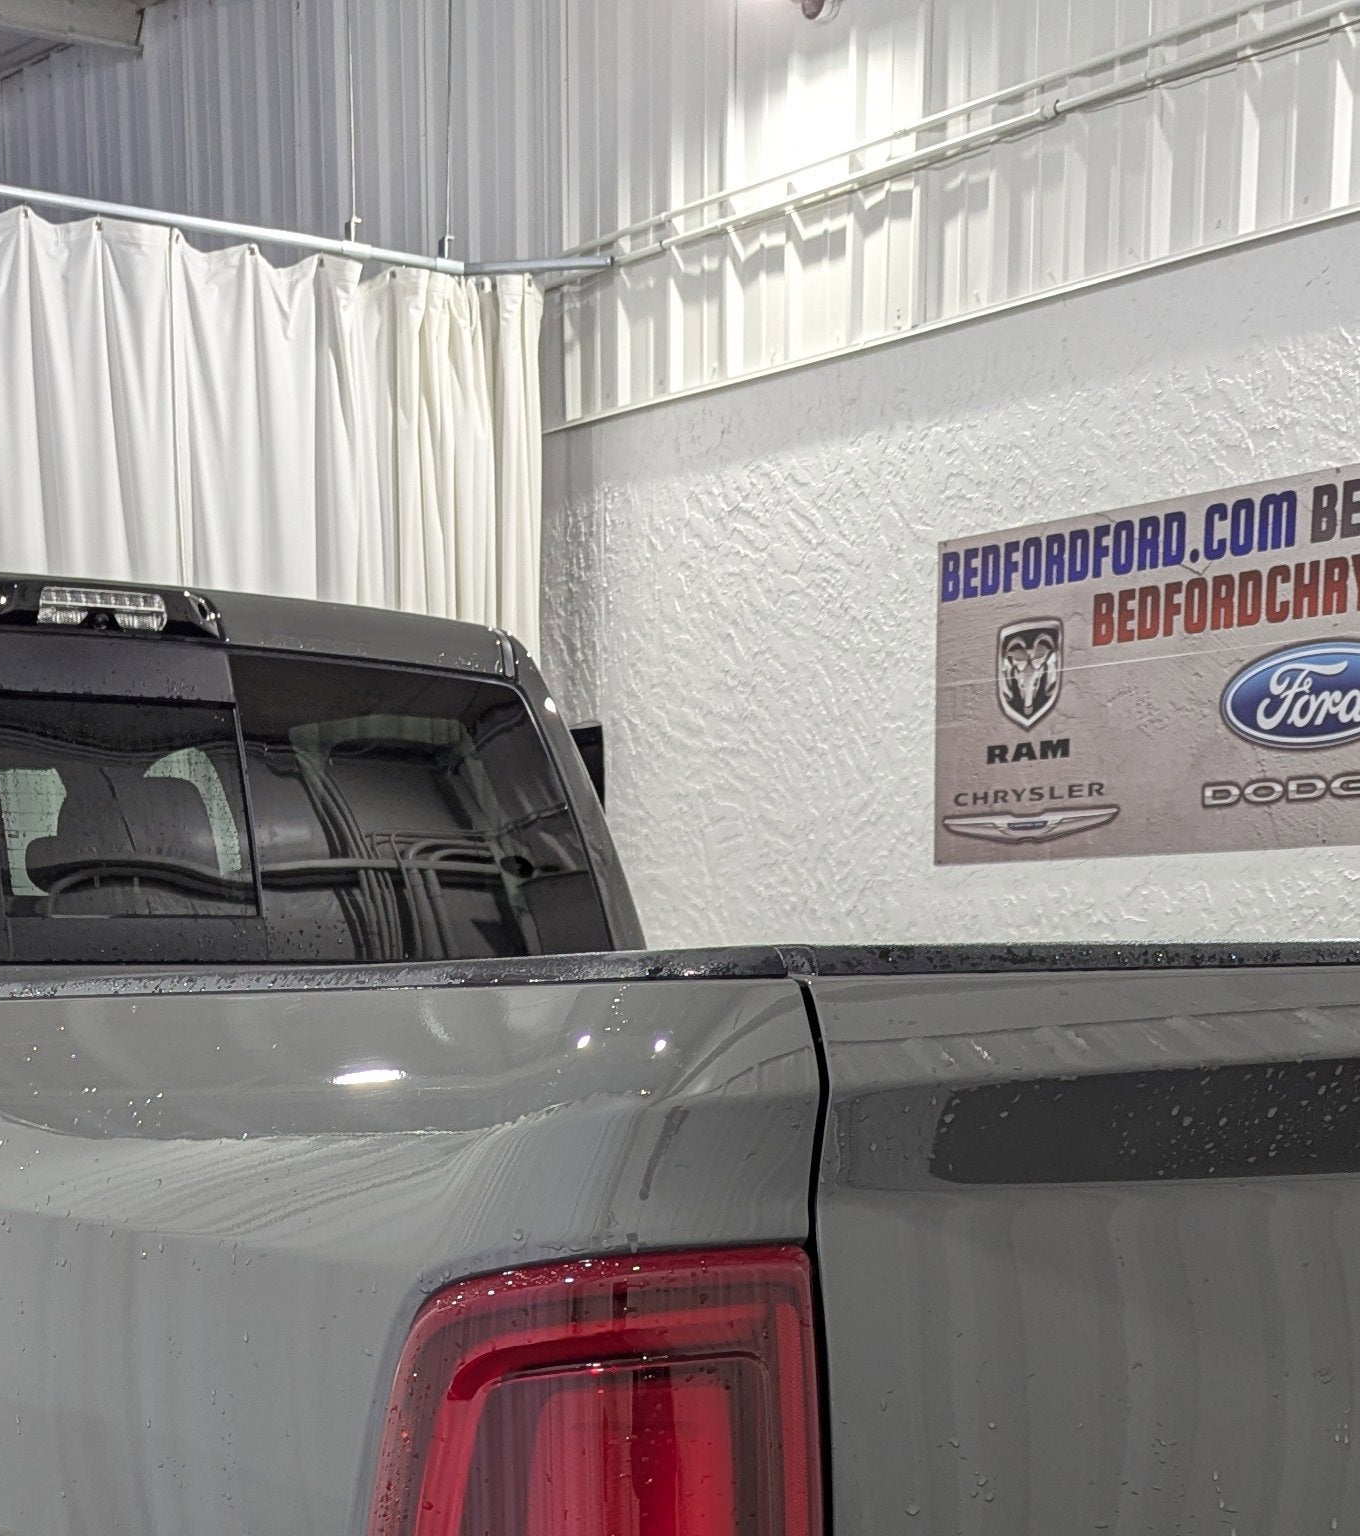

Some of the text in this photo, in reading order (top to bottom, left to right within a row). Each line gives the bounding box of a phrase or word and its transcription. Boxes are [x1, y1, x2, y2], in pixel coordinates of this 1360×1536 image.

[941, 489, 1297, 602] BEDFORDFORD.COM
[986, 738, 1070, 765] RAM
[953, 782, 1105, 807] CHRYSLER
